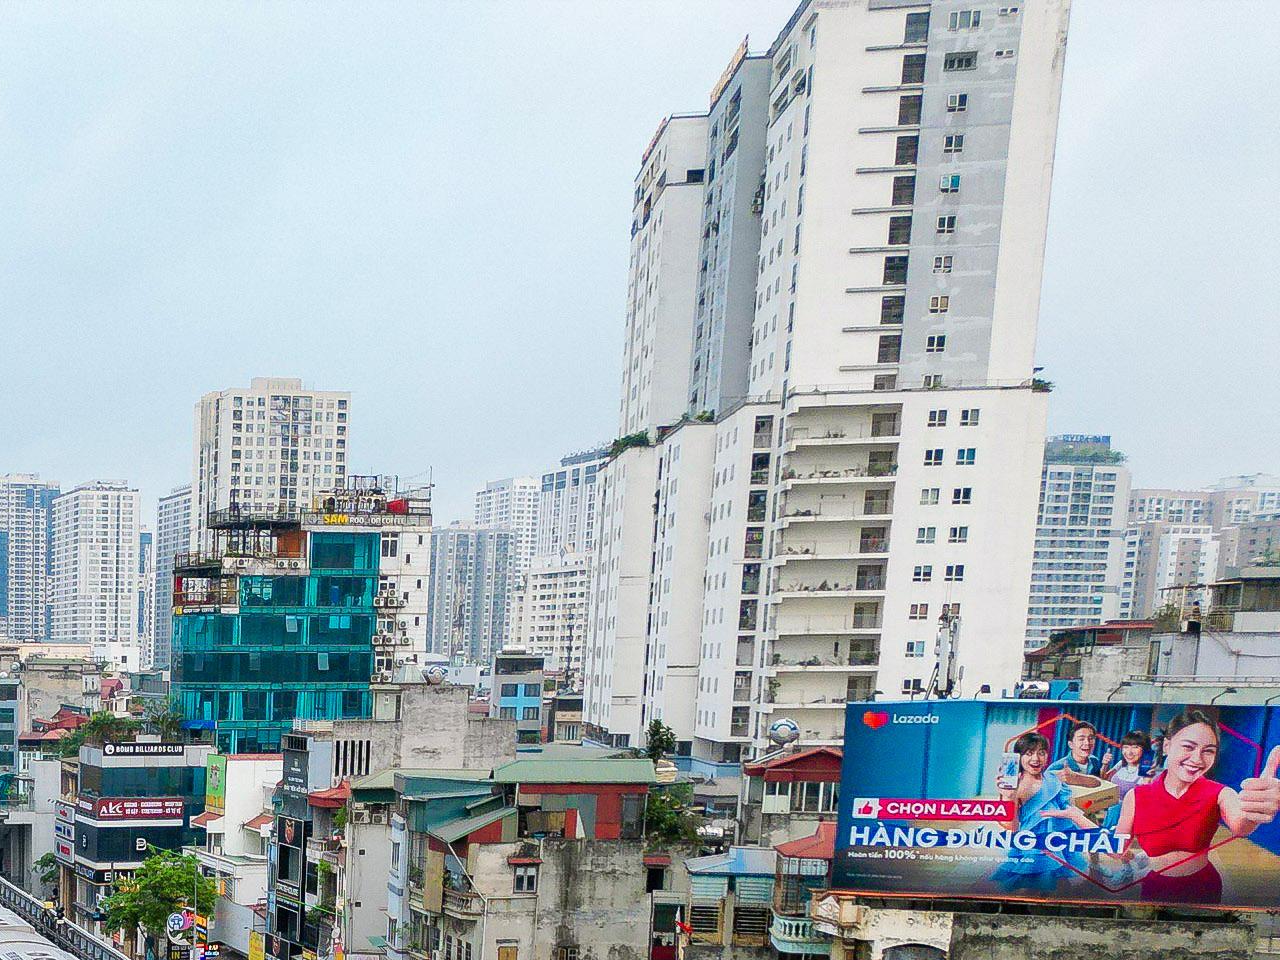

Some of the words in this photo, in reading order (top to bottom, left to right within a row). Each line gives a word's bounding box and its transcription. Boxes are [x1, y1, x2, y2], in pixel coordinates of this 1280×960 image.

[323, 513, 350, 525] SAM
[893, 713, 939, 724] Lazada
[135, 745, 167, 753] BILLIARDS
[167, 745, 183, 753] CLUB
[886, 802, 938, 818] CHỌN
[940, 803, 1007, 817] LAZADA
[849, 822, 939, 849] HÀNG
[946, 826, 1038, 851] ĐỨNG
[1044, 826, 1130, 854] CHẤT
